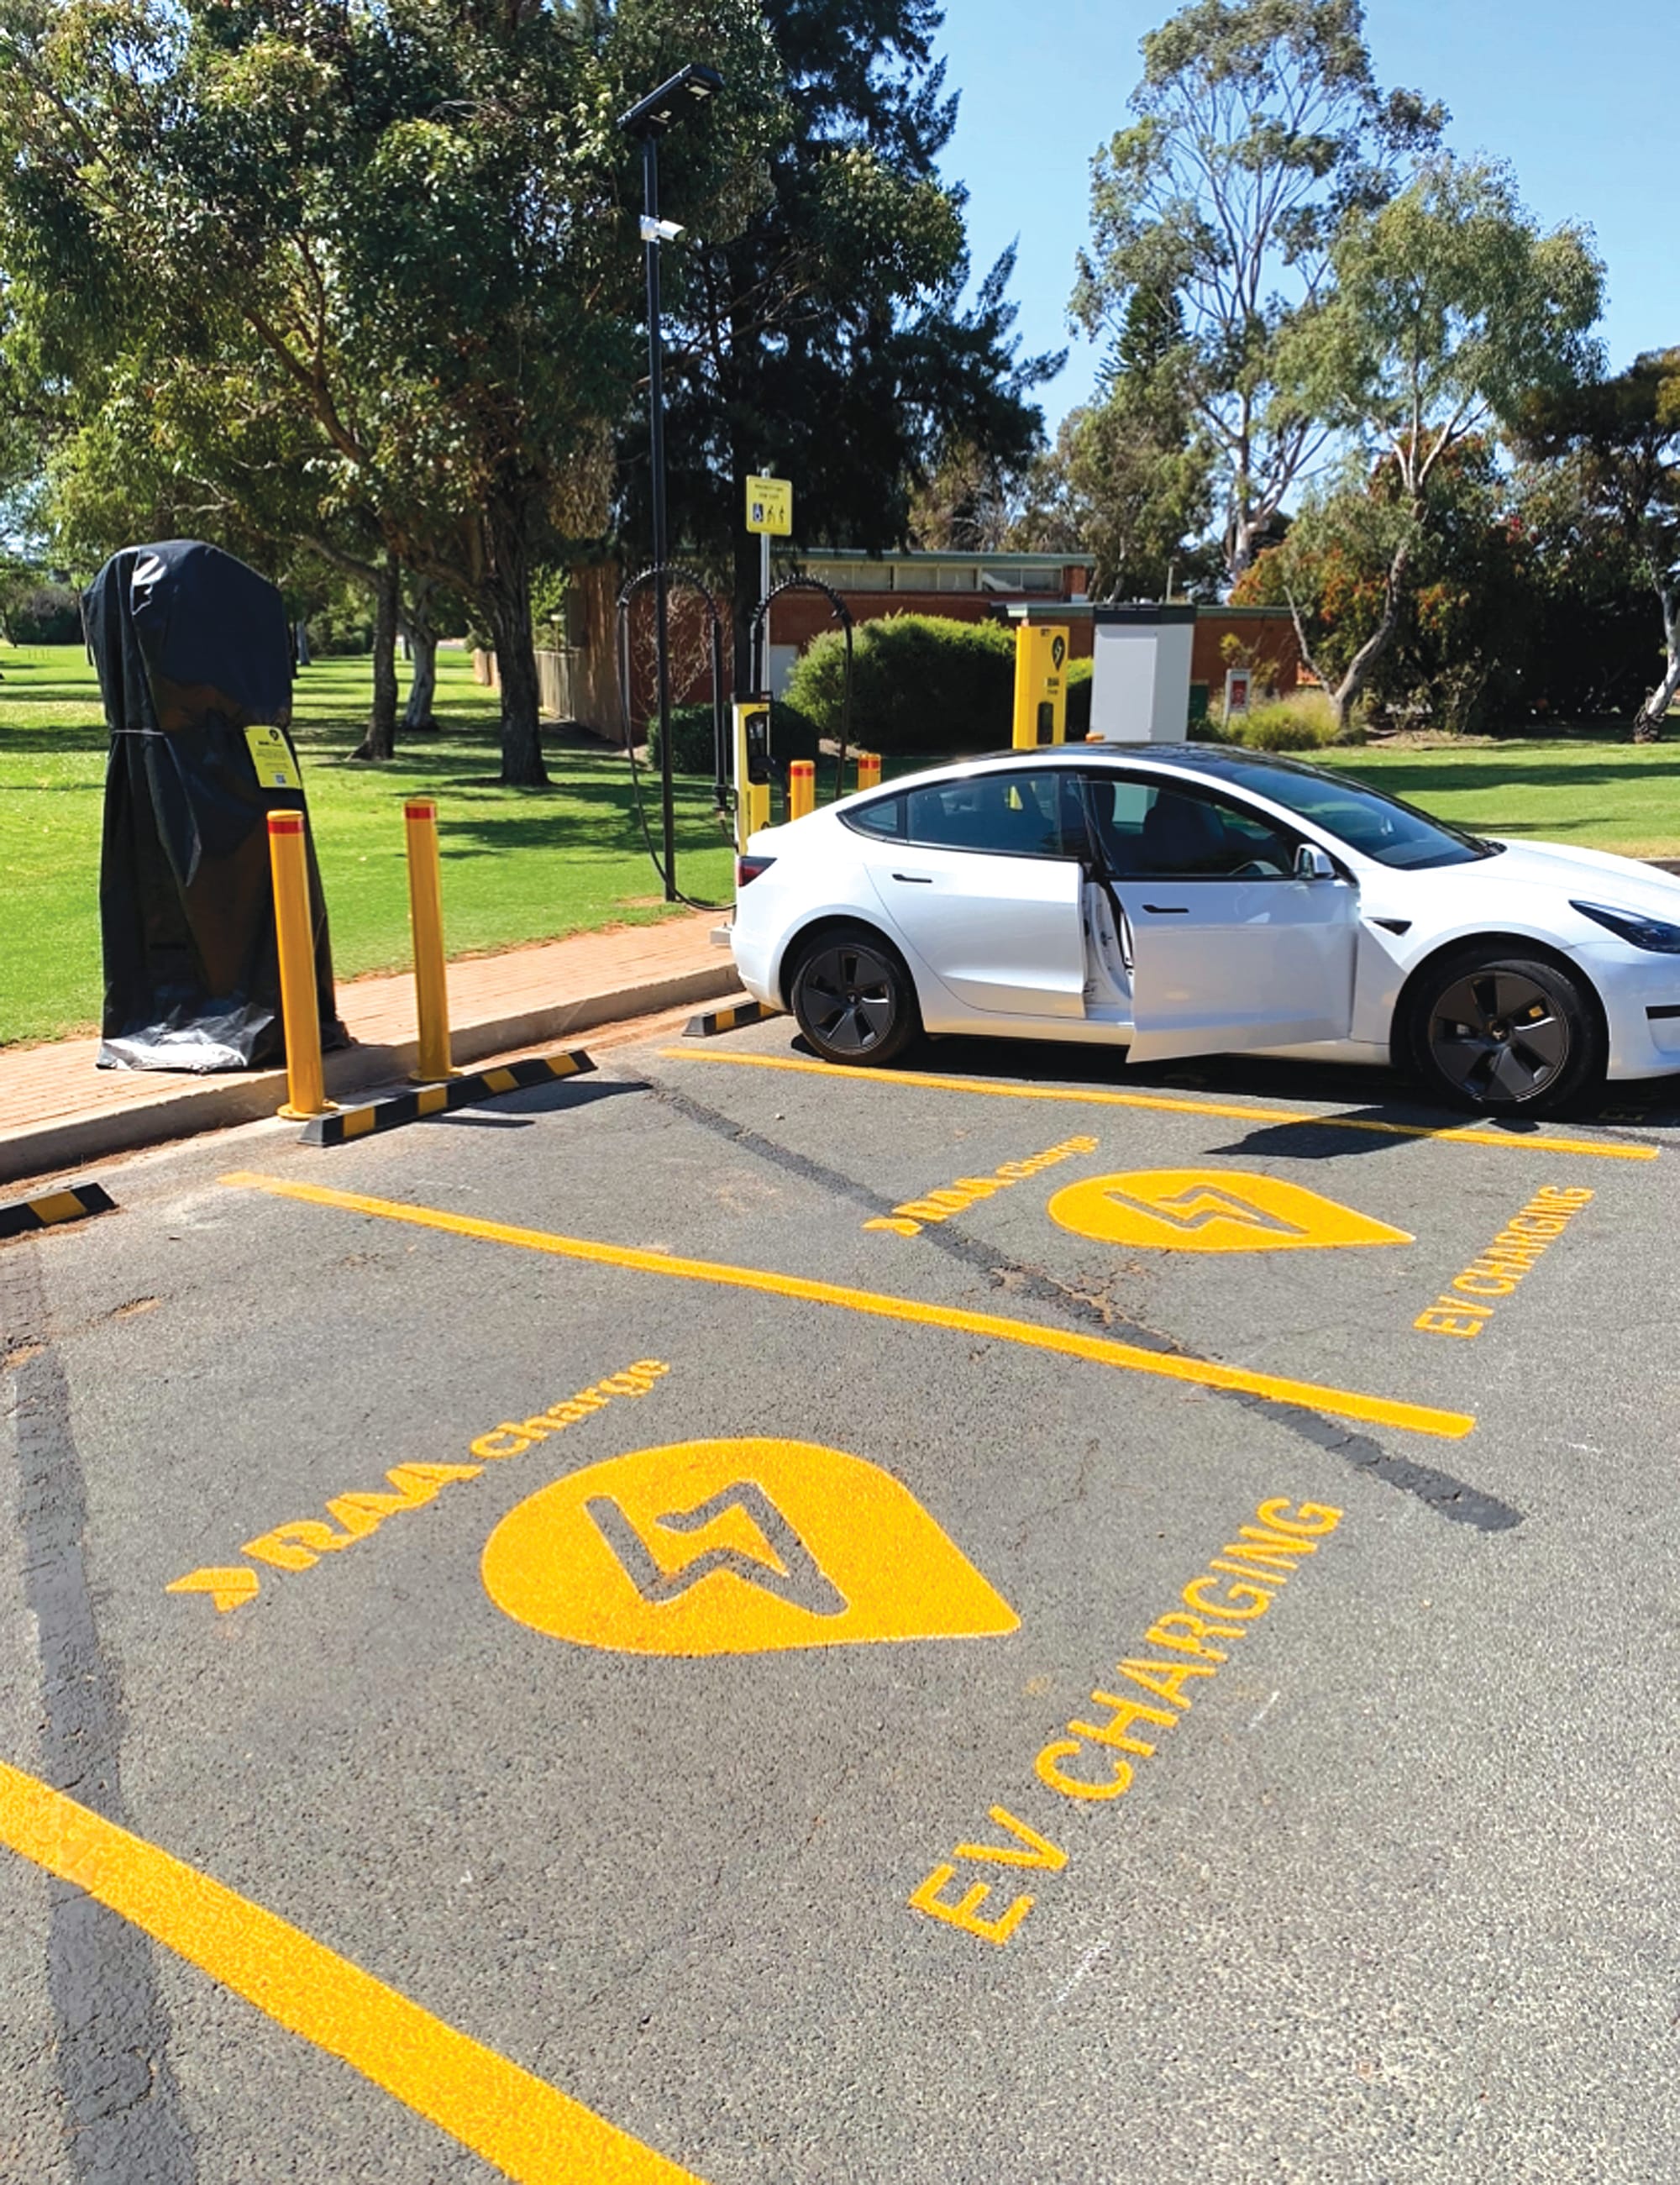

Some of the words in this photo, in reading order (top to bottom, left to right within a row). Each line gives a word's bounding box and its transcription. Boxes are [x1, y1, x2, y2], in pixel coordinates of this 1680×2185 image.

[1413, 1295, 1494, 1339] EV
[1452, 1184, 1596, 1297] CHARGING
[241, 1462, 485, 1573] RAA
[470, 1358, 669, 1460] Charge
[908, 1804, 1069, 1947] EV
[1033, 1496, 1344, 1802] CHARGING
